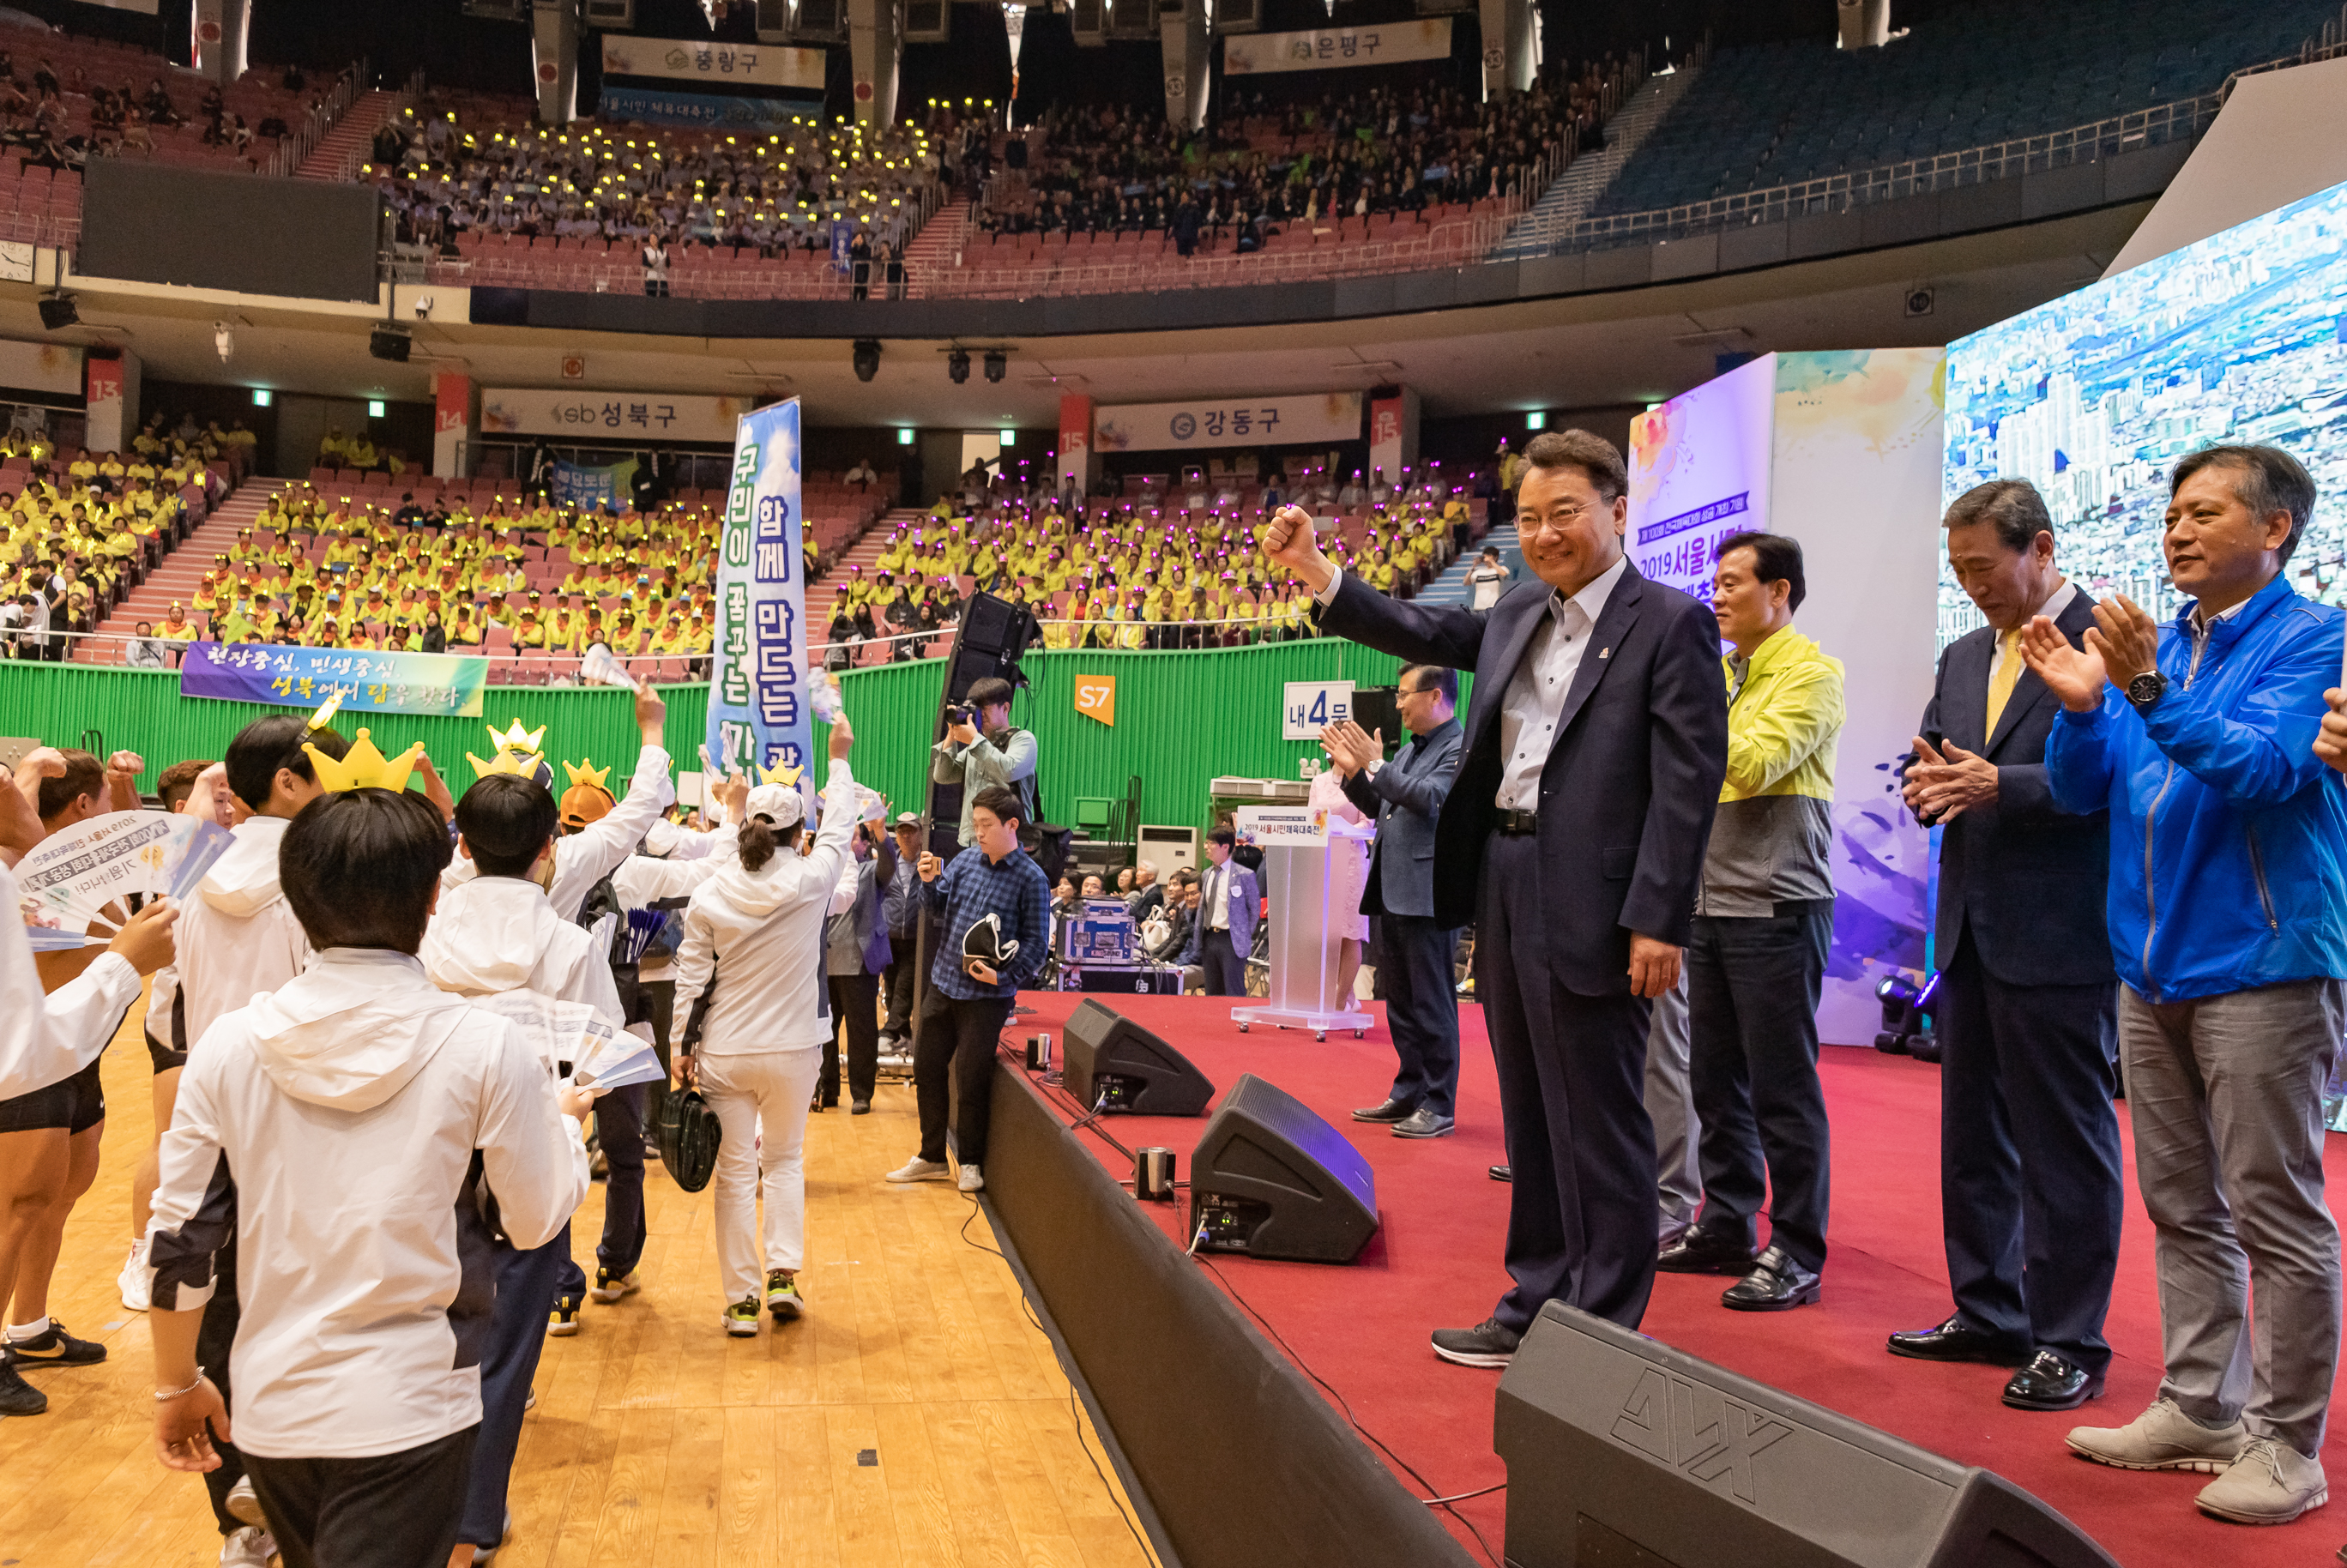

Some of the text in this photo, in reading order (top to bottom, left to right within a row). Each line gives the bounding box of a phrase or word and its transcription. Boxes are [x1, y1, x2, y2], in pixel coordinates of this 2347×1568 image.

[1316, 32, 1381, 59] 은평구
[695, 50, 759, 74] 중랑구
[93, 380, 118, 401] 13
[439, 410, 463, 430] 14
[601, 402, 677, 428] 성북구
[1204, 407, 1281, 437] 강동구
[1062, 431, 1083, 452] 15
[1374, 422, 1397, 443] 15
[727, 444, 759, 565] 구민이
[757, 498, 787, 582] 함께
[1640, 524, 1742, 579] 2019 서울시
[723, 584, 748, 704] 꿈꾸는
[757, 601, 795, 726] 만드는
[271, 674, 360, 702] 성북에서
[367, 682, 410, 707] 답을
[1078, 684, 1111, 709] S7
[1245, 823, 1258, 832] 2019
